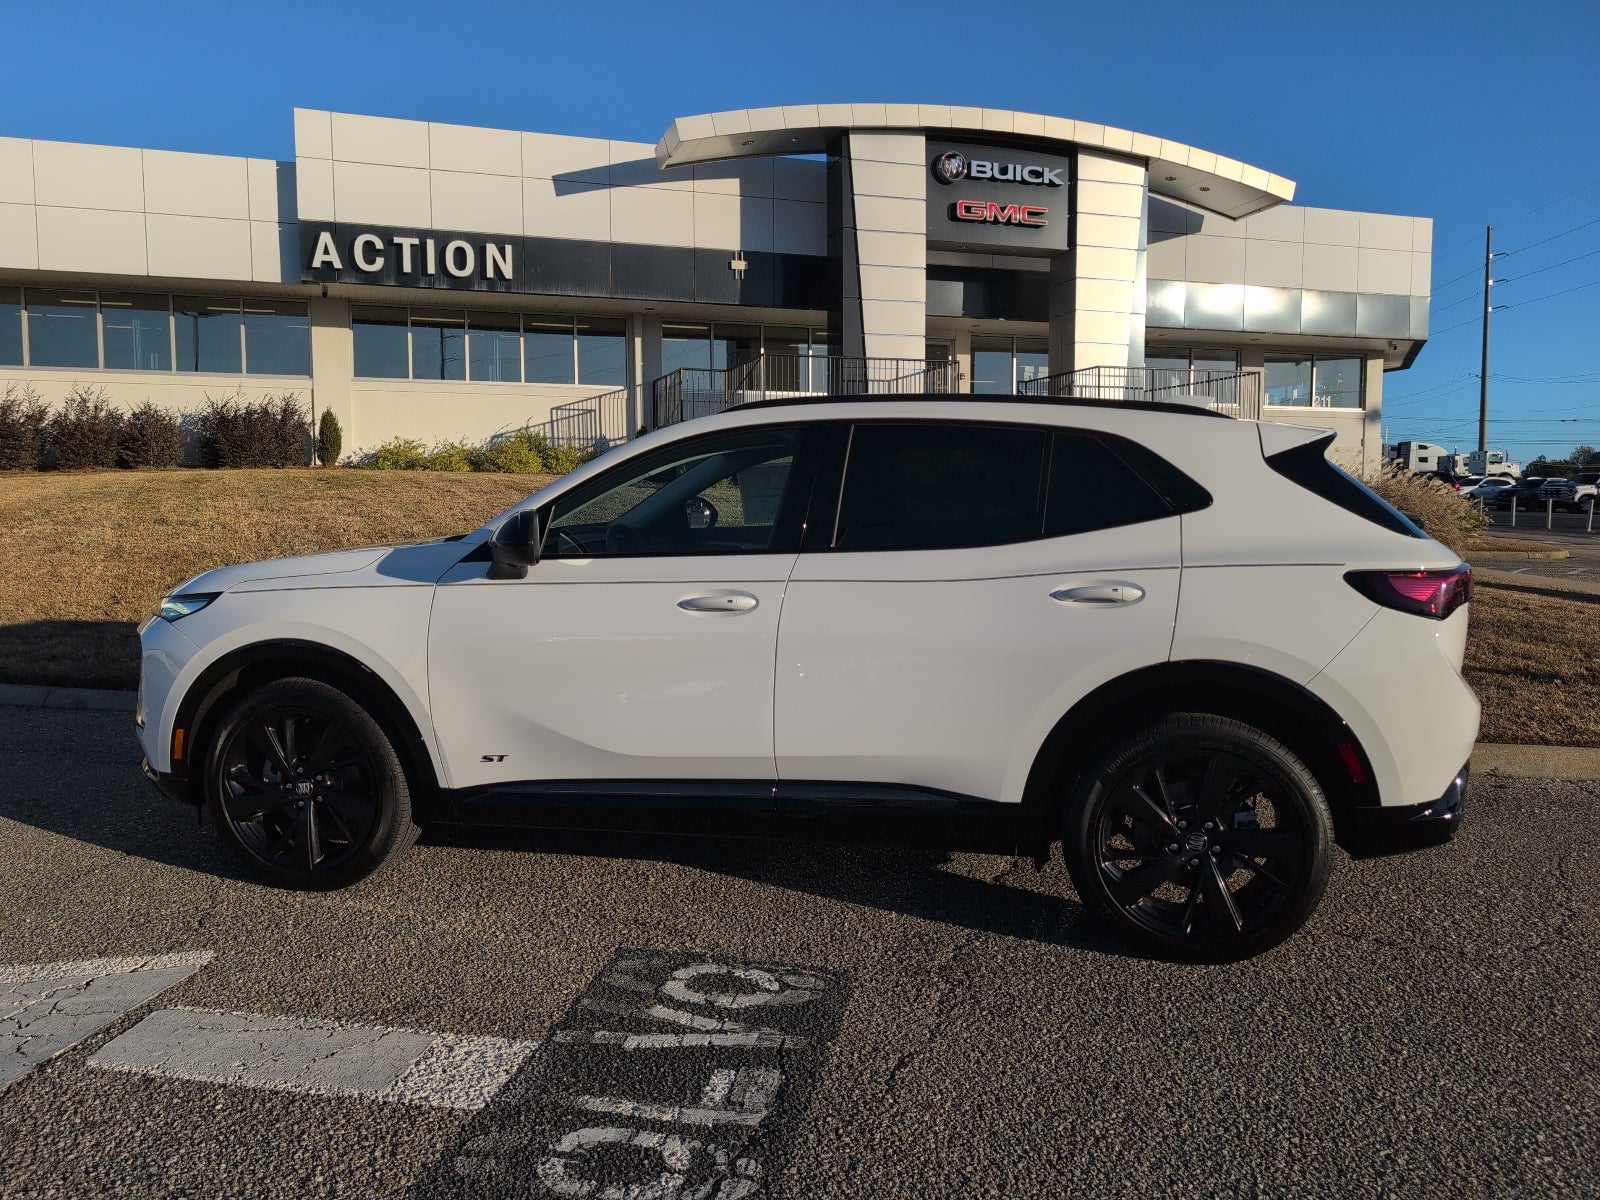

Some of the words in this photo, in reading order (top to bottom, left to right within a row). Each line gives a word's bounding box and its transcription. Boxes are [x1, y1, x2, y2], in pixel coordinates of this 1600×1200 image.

[970, 160, 1064, 185] BUICK
[957, 200, 1048, 225] GMC
[311, 231, 513, 280] ACTION
[1314, 395, 1331, 408] 211
[479, 754, 509, 763] ST
